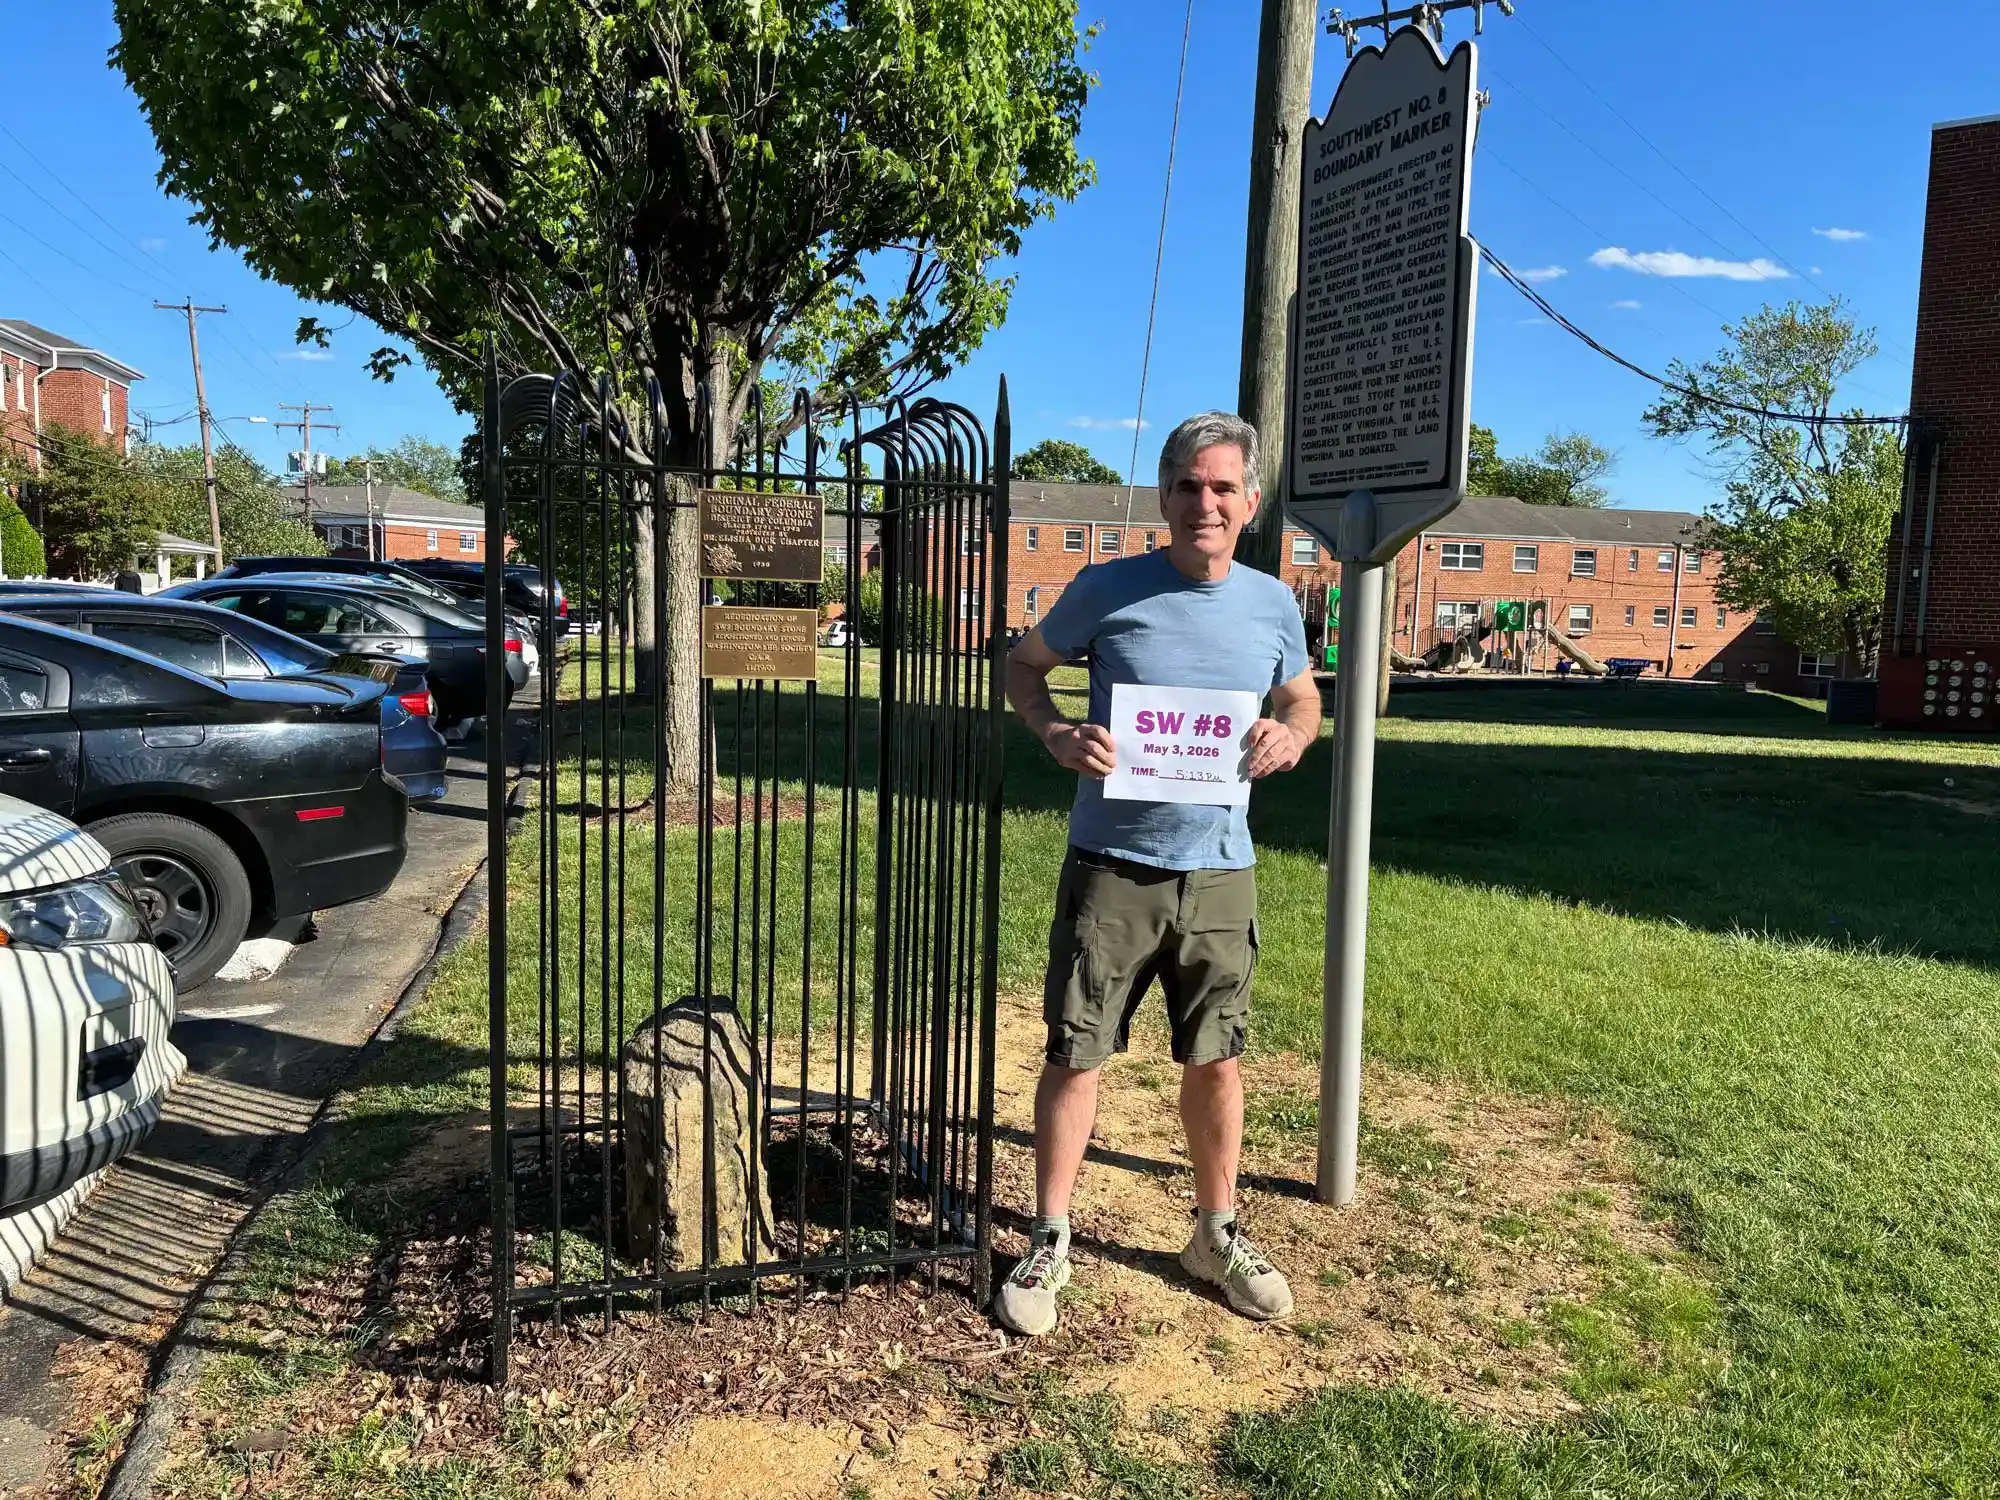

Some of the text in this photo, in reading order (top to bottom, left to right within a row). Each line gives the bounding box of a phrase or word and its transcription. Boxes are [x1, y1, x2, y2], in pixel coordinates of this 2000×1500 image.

[1320, 107, 1402, 159] SOUTHWEST
[1437, 86, 1447, 105] 8
[1313, 111, 1452, 185] BOUNDARY MARKER
[765, 497, 816, 510] FEDERAL
[711, 505, 814, 519] BOUNDARY STONE
[768, 518, 812, 527] COLUMBIA
[780, 538, 820, 547] CHAPTER
[1136, 710, 1232, 738] SW #8
[1144, 744, 1219, 757] May 3, 2026
[1131, 767, 1159, 777] TIME:
